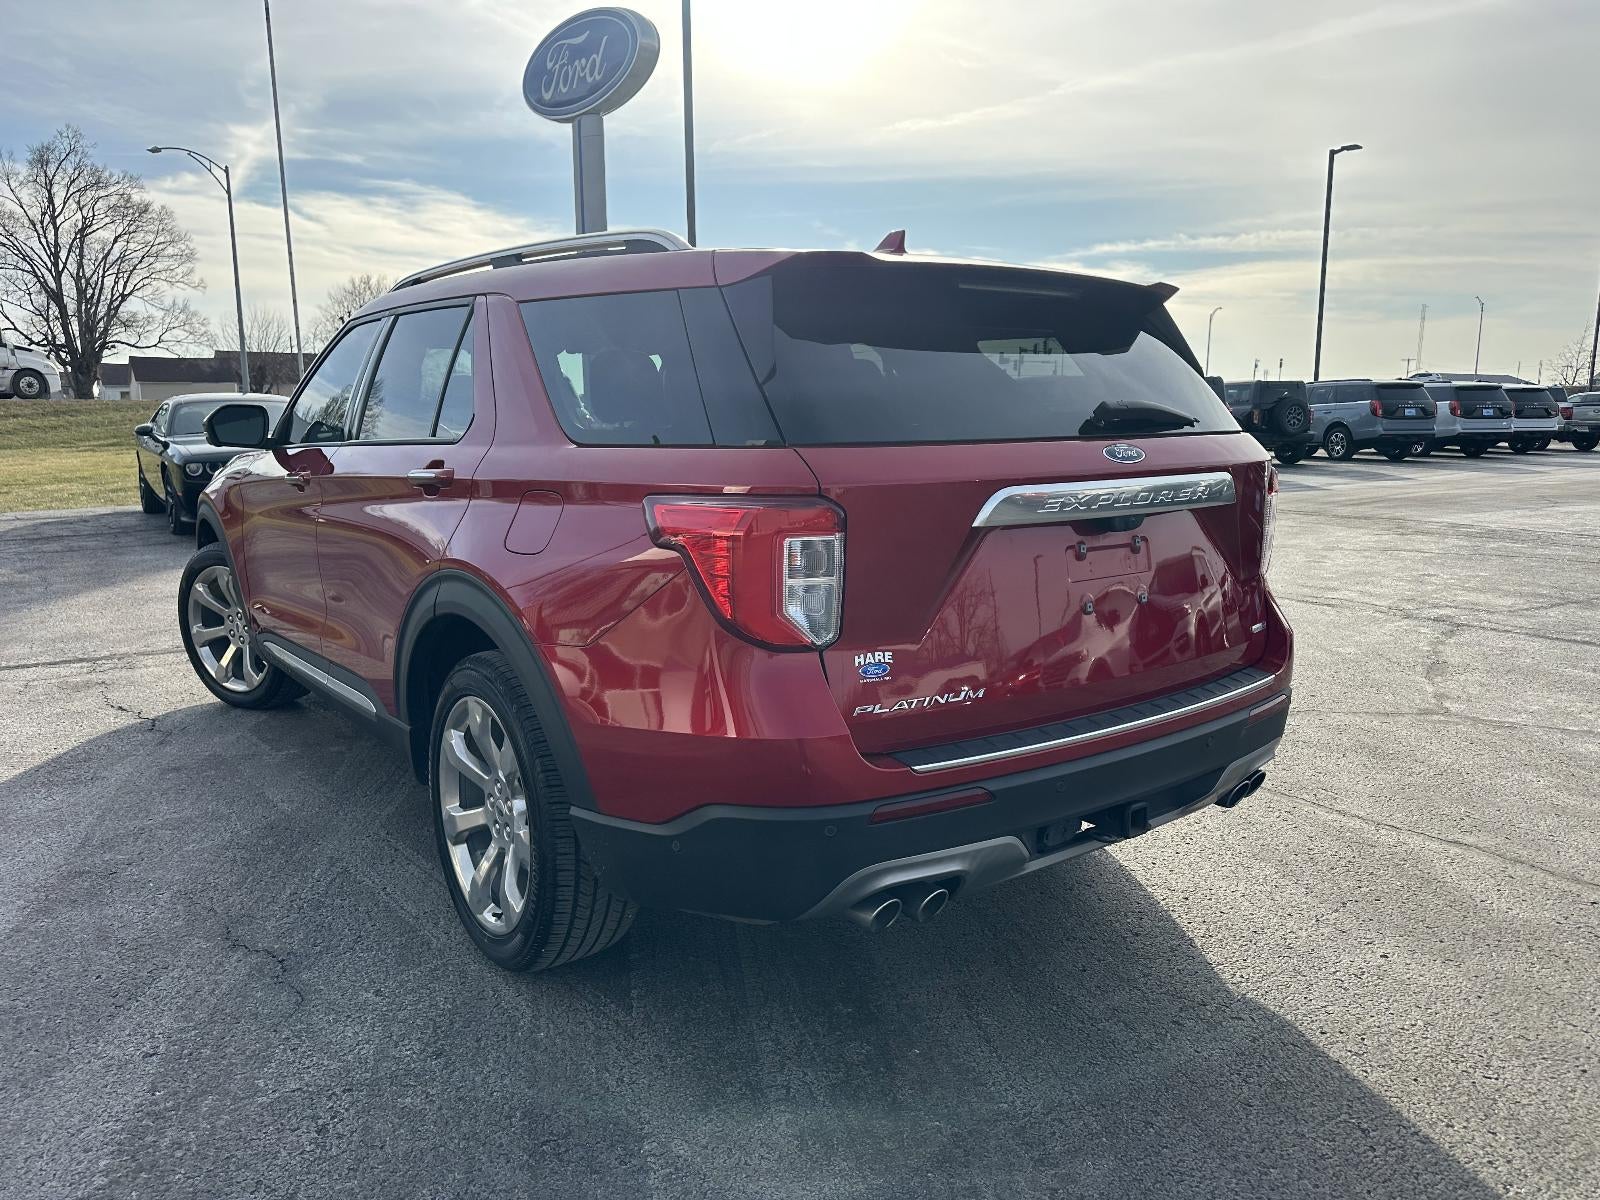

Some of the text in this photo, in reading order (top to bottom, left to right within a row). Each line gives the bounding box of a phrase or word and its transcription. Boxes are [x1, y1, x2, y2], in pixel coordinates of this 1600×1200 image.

[541, 30, 608, 100] Ford
[1114, 446, 1138, 458] Ford
[1036, 486, 1210, 513] EXPLORER
[854, 651, 893, 667] HARE
[866, 666, 884, 675] Ford
[852, 687, 987, 717] PLATINUM
